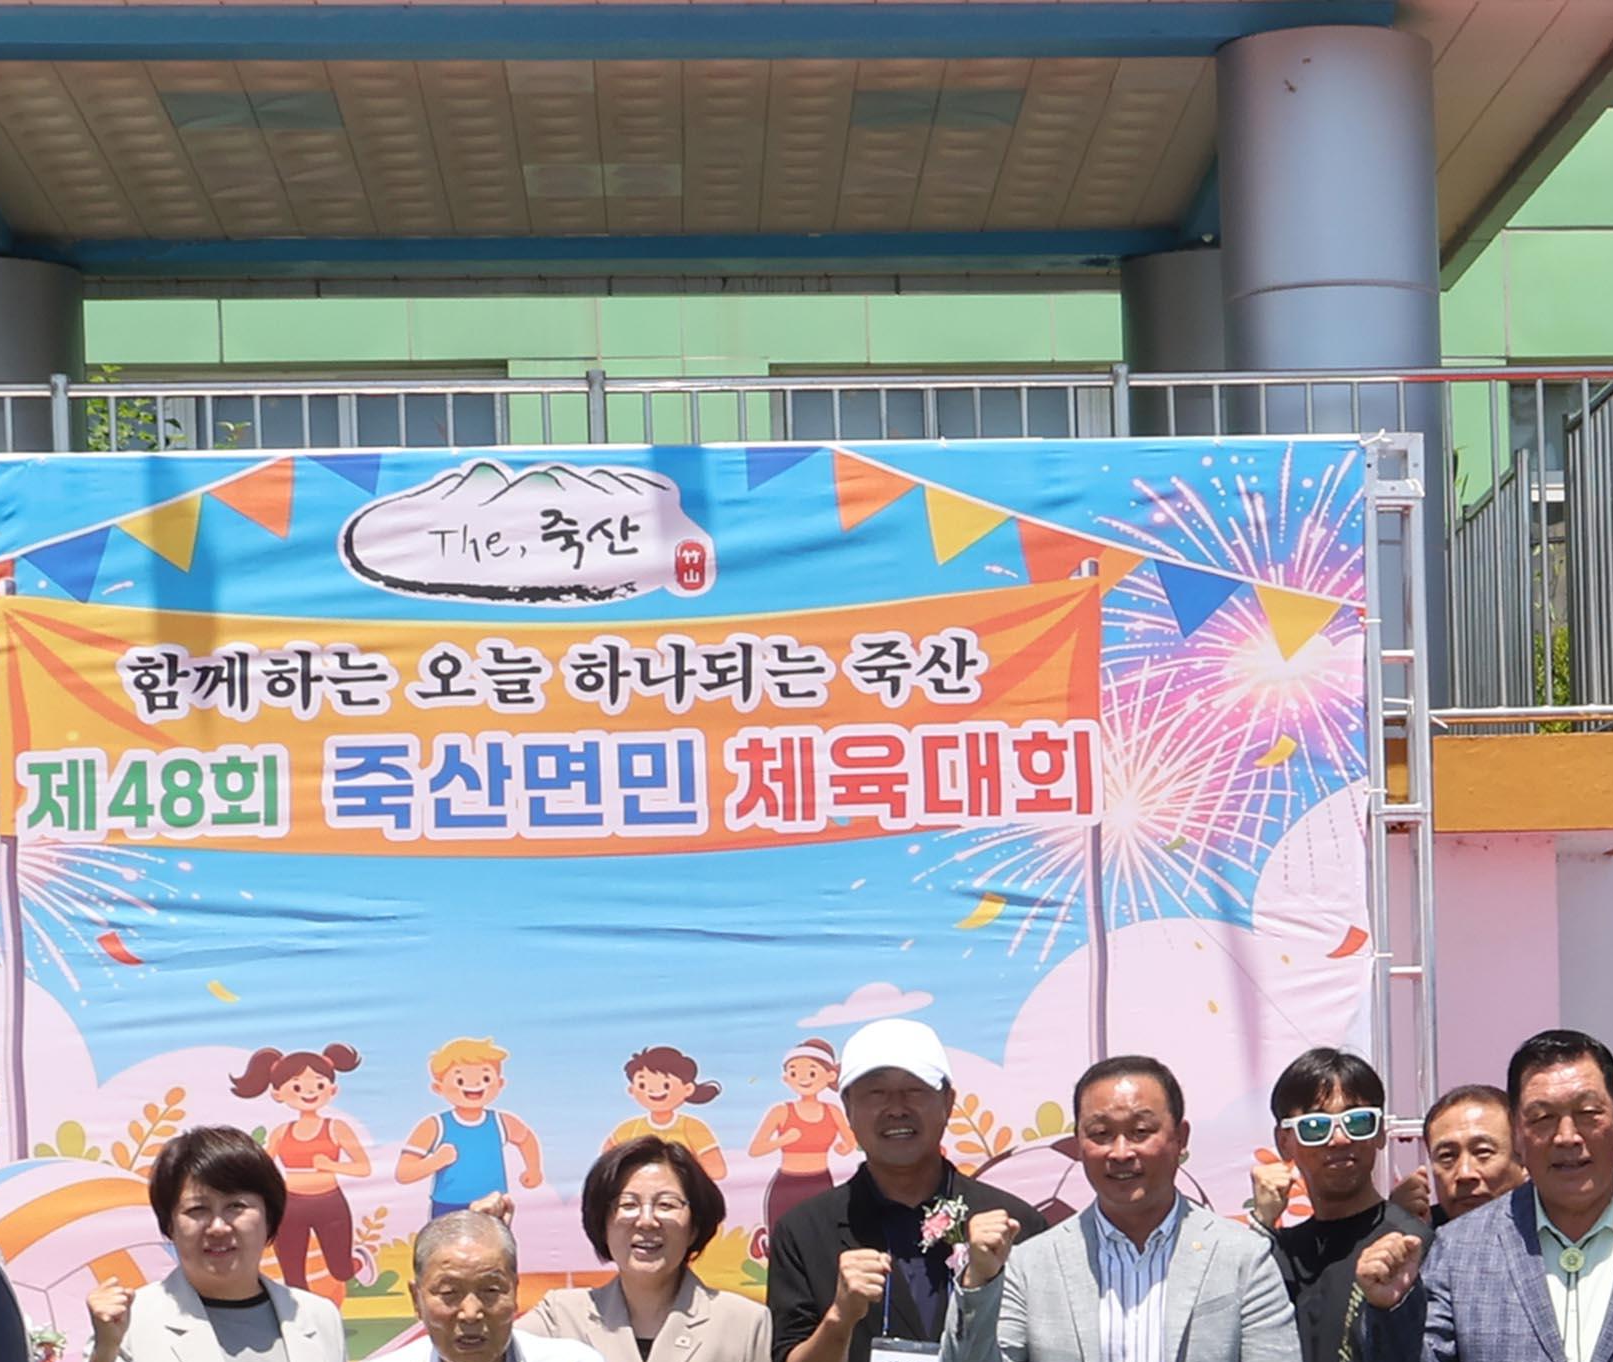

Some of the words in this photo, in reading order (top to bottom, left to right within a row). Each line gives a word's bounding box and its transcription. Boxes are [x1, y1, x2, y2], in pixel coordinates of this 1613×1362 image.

[540, 508, 641, 570] 죽산
[126, 650, 390, 716] 함께하는
[415, 646, 543, 706] 오늘
[570, 641, 826, 706] 하나되는
[852, 636, 978, 700] 죽산
[26, 753, 279, 833] 제48회
[331, 737, 698, 830] 죽산면민
[733, 730, 1094, 823] 체육대회
